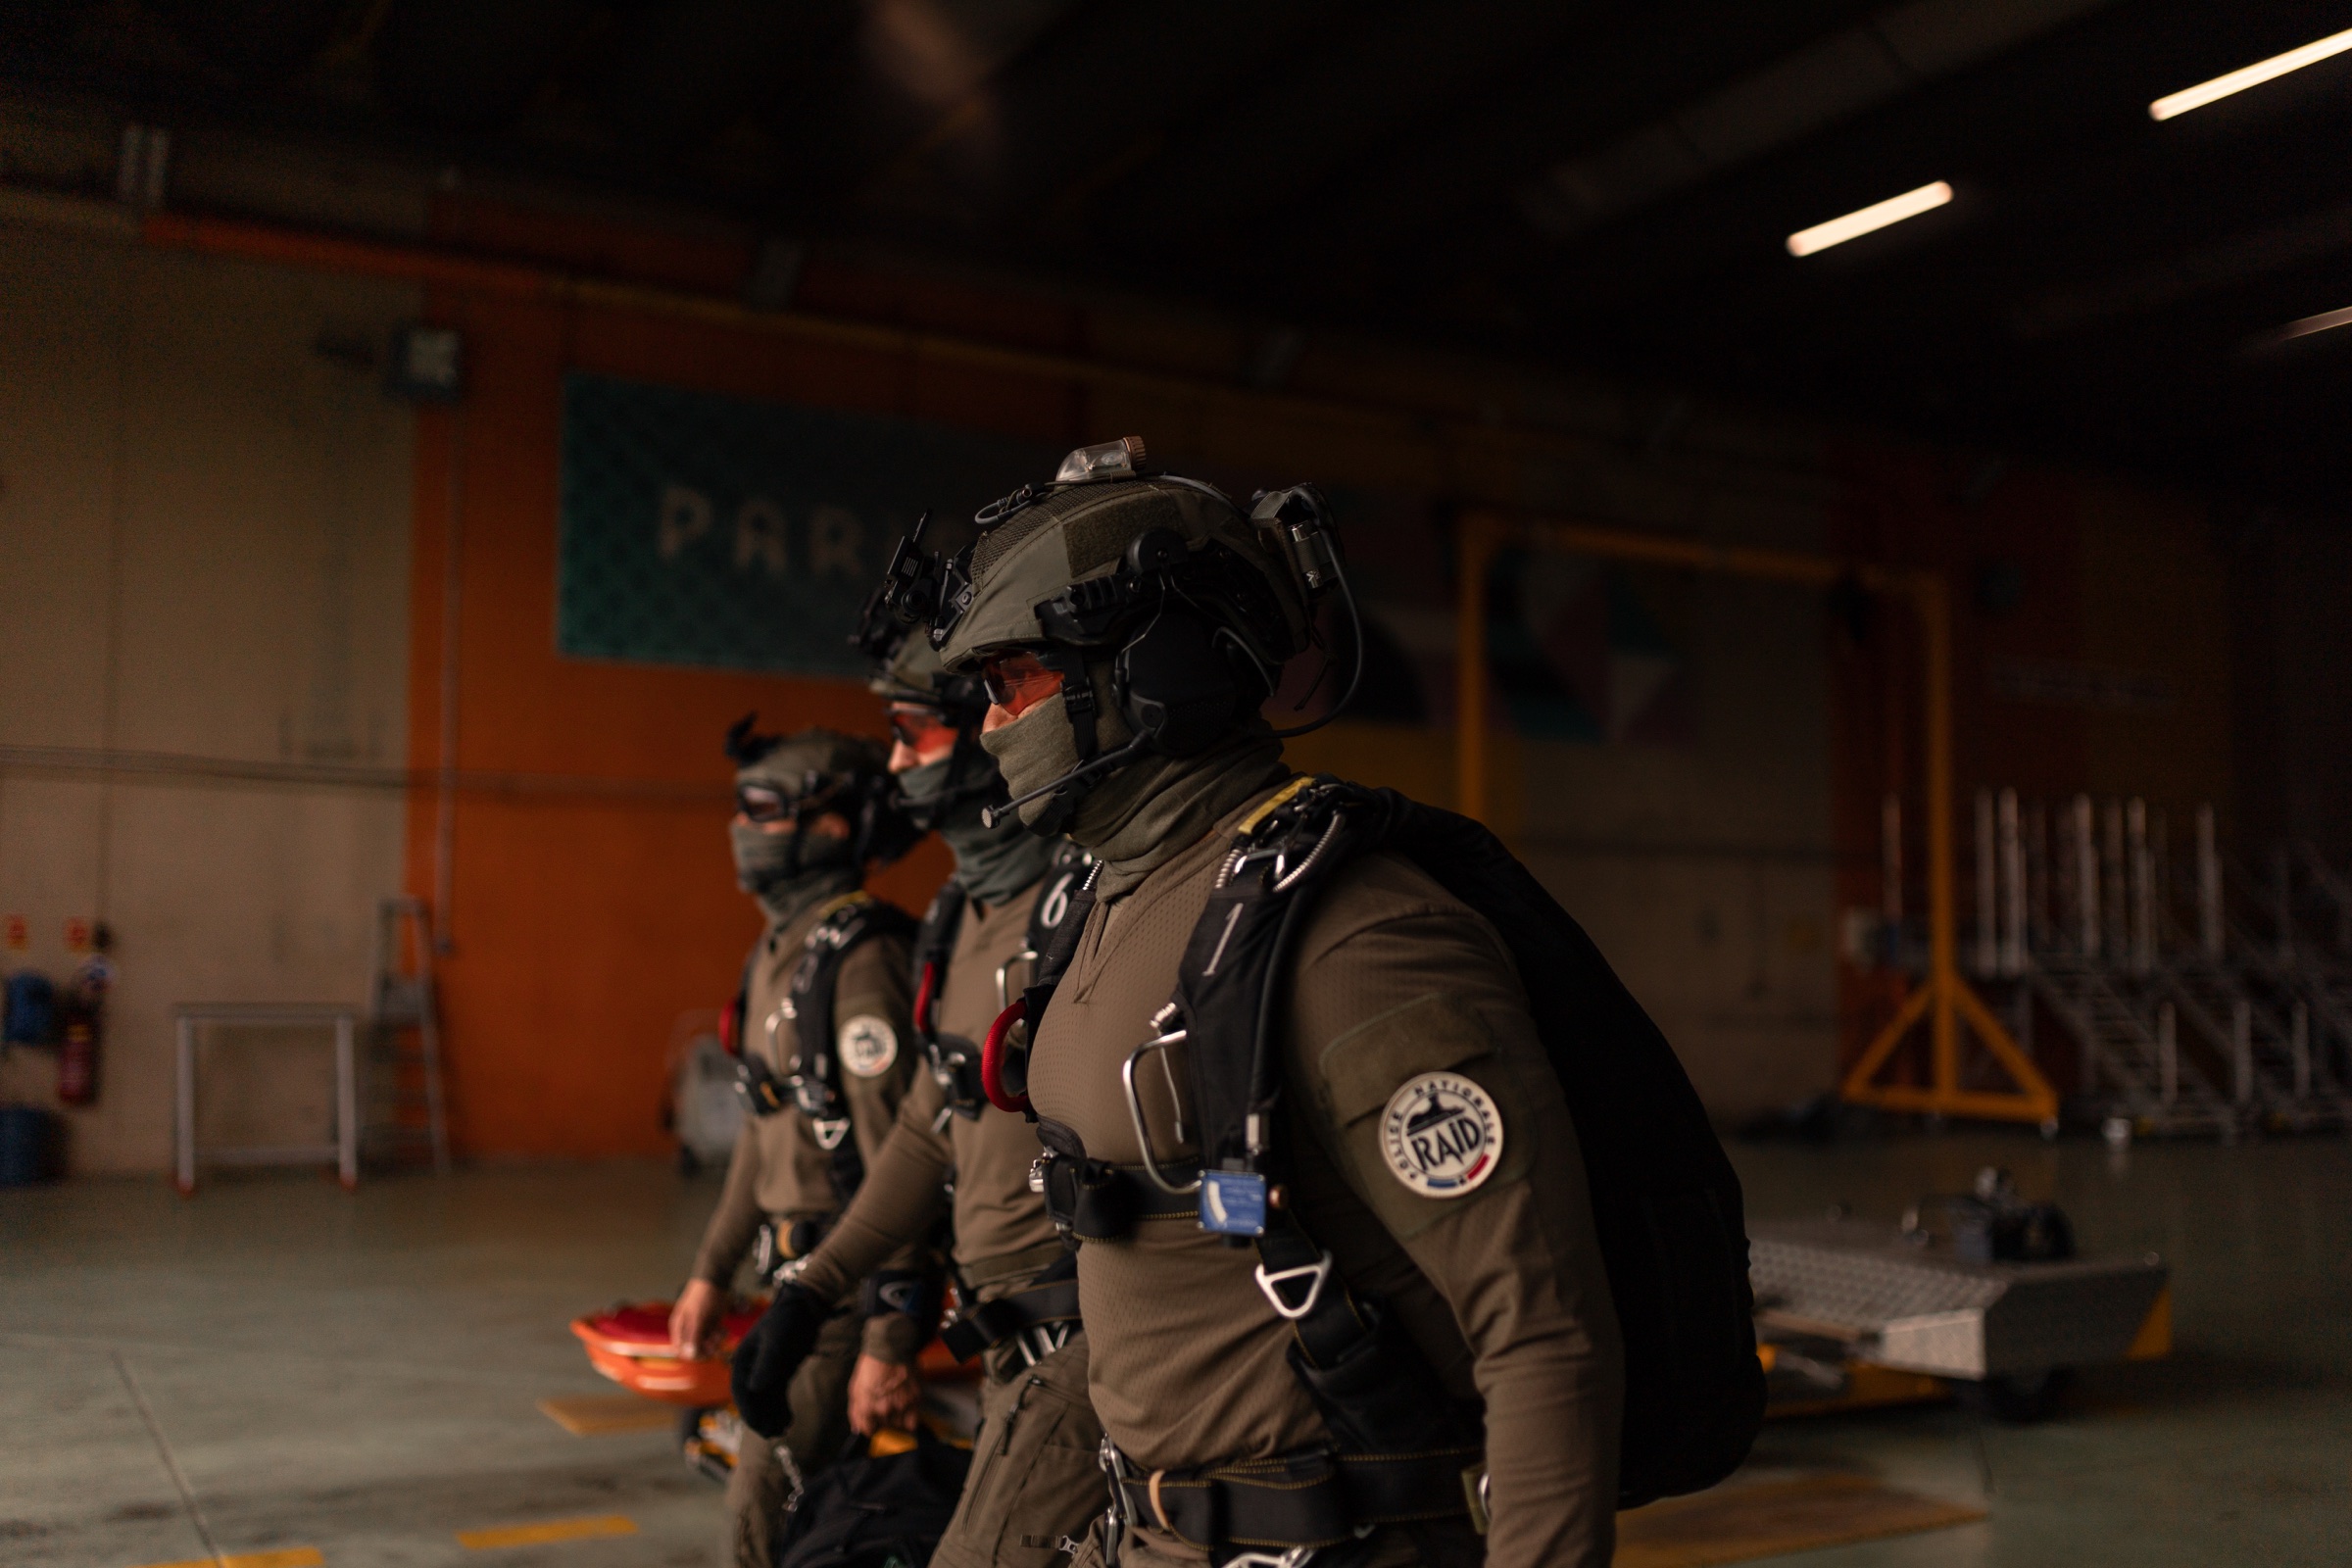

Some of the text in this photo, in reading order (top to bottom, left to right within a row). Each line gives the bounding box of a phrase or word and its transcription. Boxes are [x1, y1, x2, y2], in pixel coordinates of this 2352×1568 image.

[658, 486, 972, 580] PAR
[1040, 871, 1075, 929] 6
[1201, 902, 1244, 976] 1
[1411, 1118, 1480, 1171] RAID
